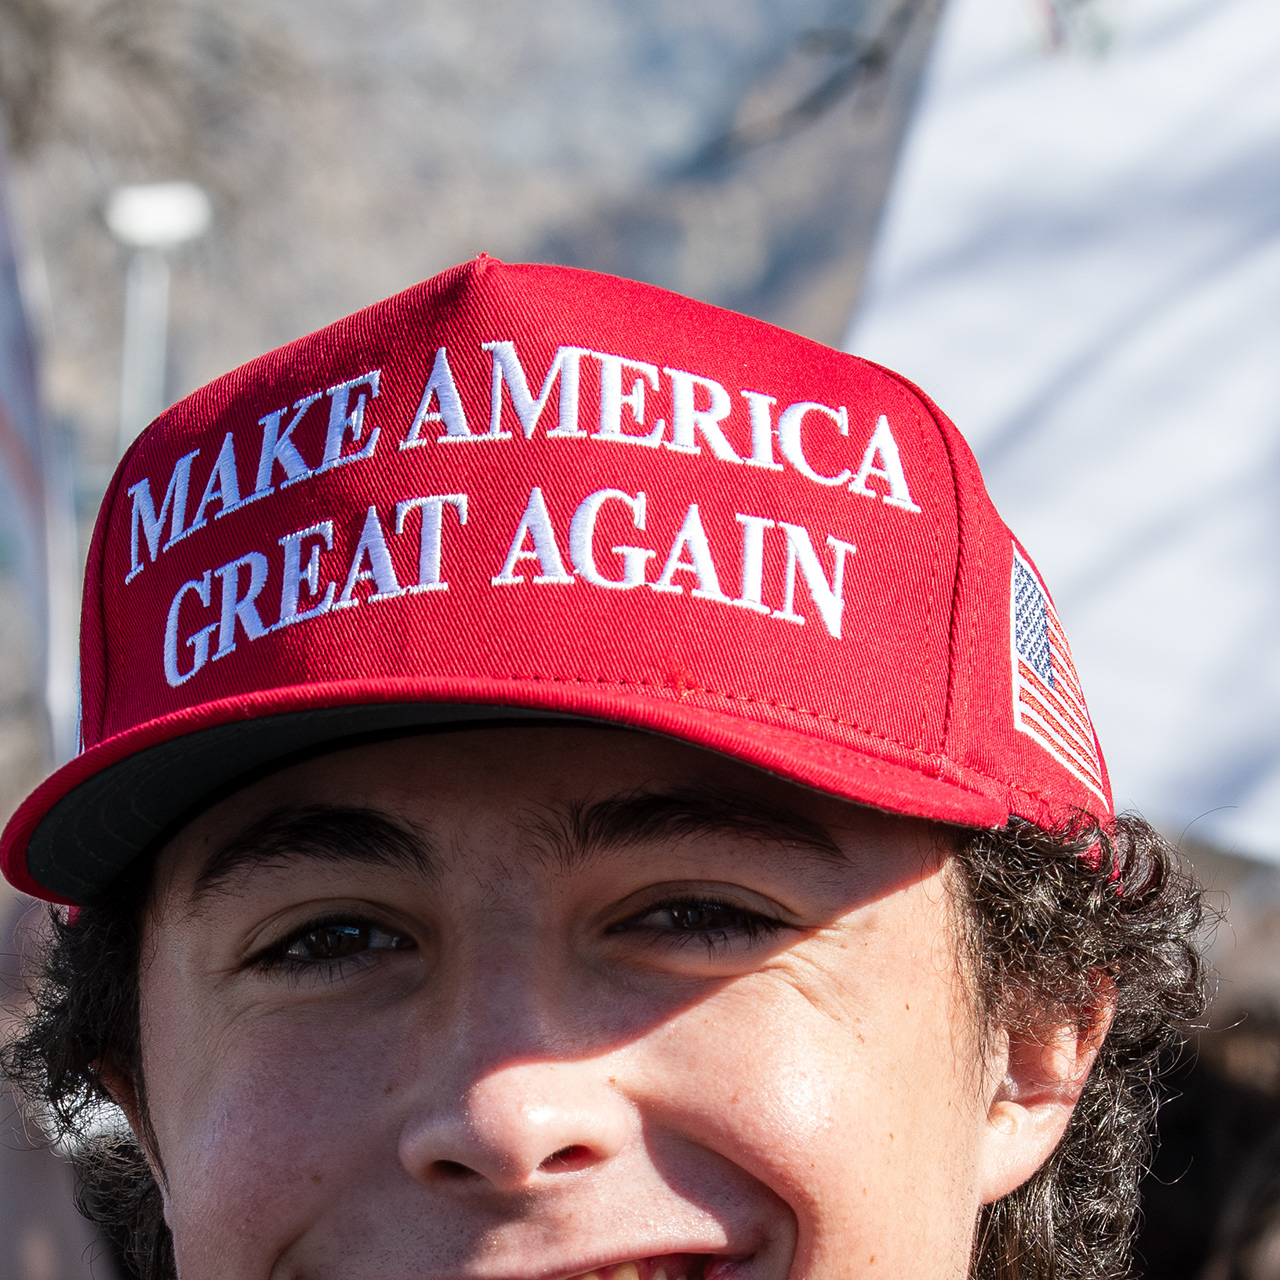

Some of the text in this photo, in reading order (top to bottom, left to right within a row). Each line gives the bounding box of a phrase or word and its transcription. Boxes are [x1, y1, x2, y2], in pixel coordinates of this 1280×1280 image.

[125, 340, 921, 581] MAKE AMERICA
[164, 487, 857, 687] GREAT AGAIN
